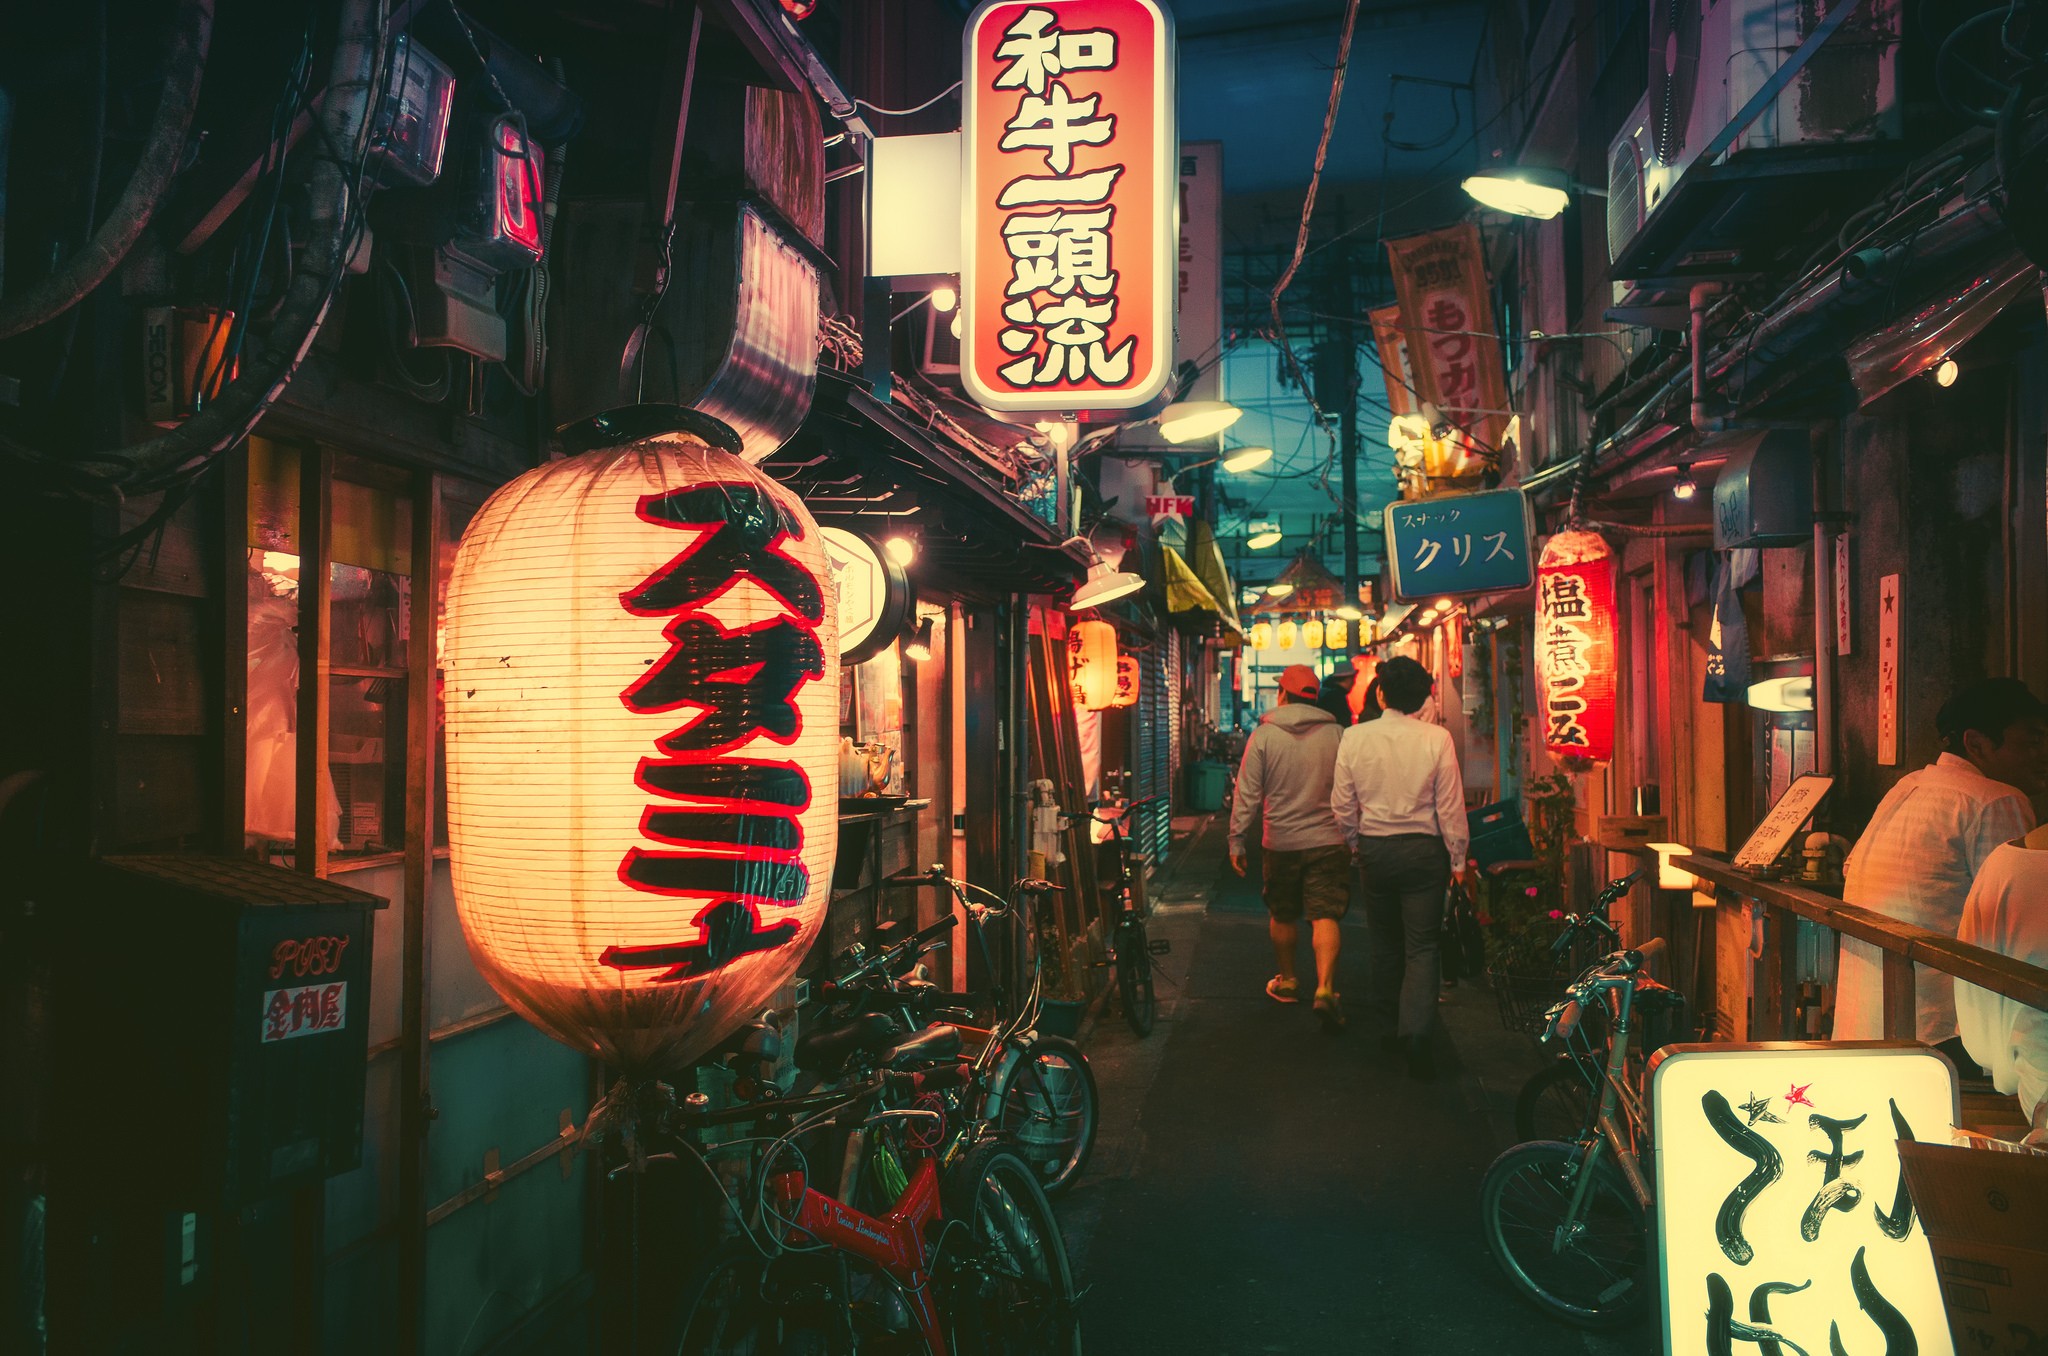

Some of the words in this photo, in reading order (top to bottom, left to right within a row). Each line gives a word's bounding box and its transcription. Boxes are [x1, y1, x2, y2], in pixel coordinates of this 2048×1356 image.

[993, 7, 1138, 388] 和牛一頭流
[148, 324, 168, 403] SECOM
[1402, 509, 1461, 529] スナック
[1413, 531, 1516, 574] クリス
[598, 480, 826, 985] スタミナ
[269, 935, 350, 979] POST
